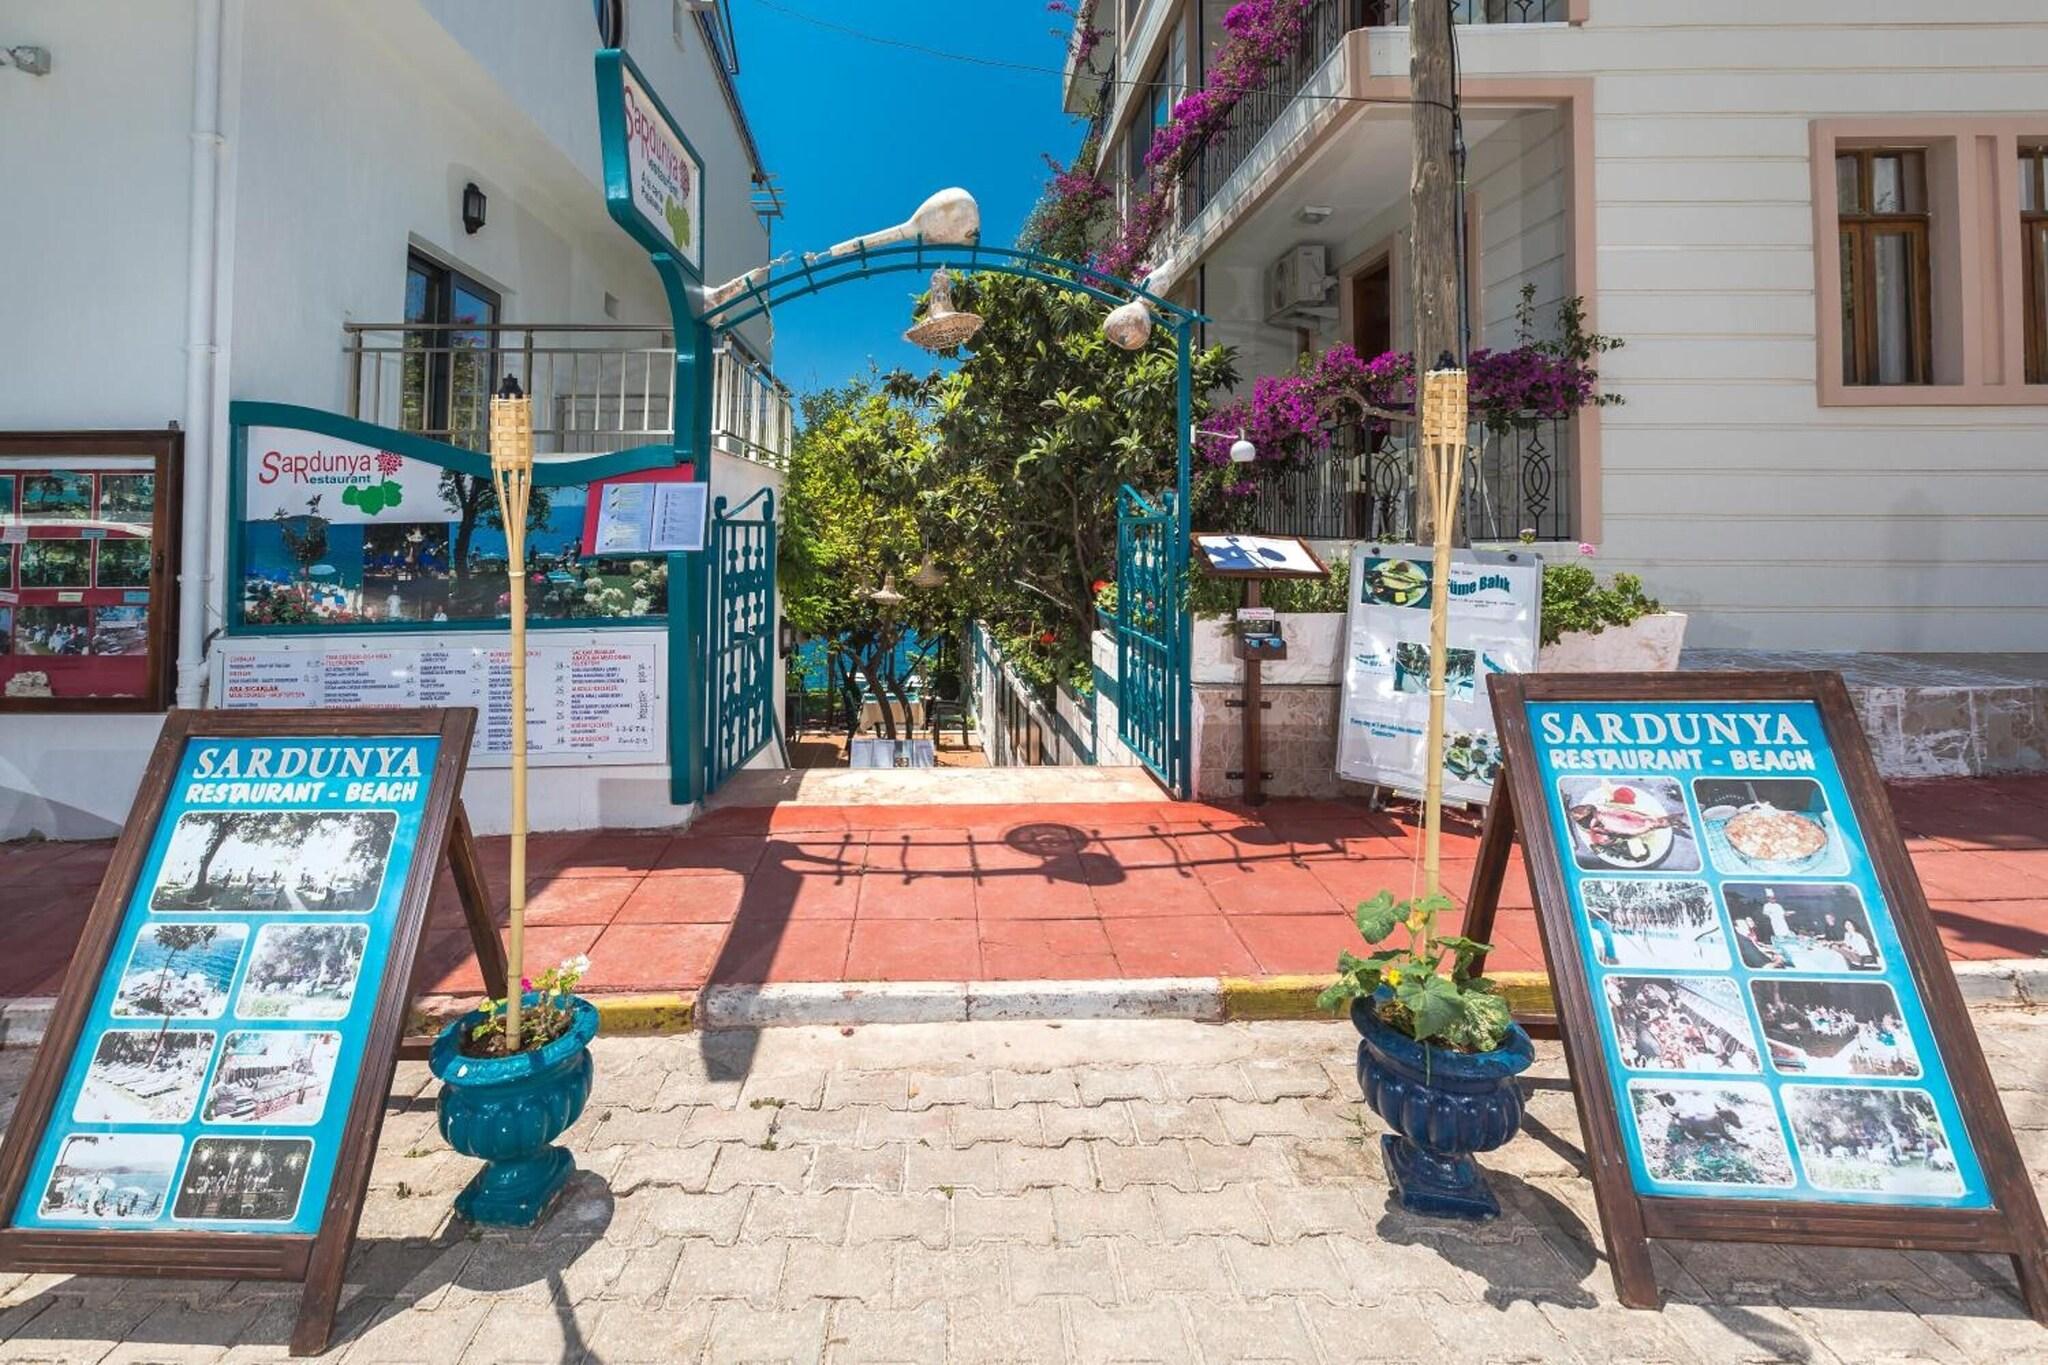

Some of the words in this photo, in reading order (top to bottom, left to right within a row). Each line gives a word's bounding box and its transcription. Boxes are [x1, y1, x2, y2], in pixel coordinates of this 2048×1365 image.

[1541, 712, 1808, 745] SARDUNYA
[192, 747, 422, 779] SARDUNYA
[1550, 748, 1703, 771] RESTAURANT
[1730, 749, 1816, 771] BEACH
[185, 782, 326, 804] RESTAURANT
[345, 781, 418, 803] BEACH
